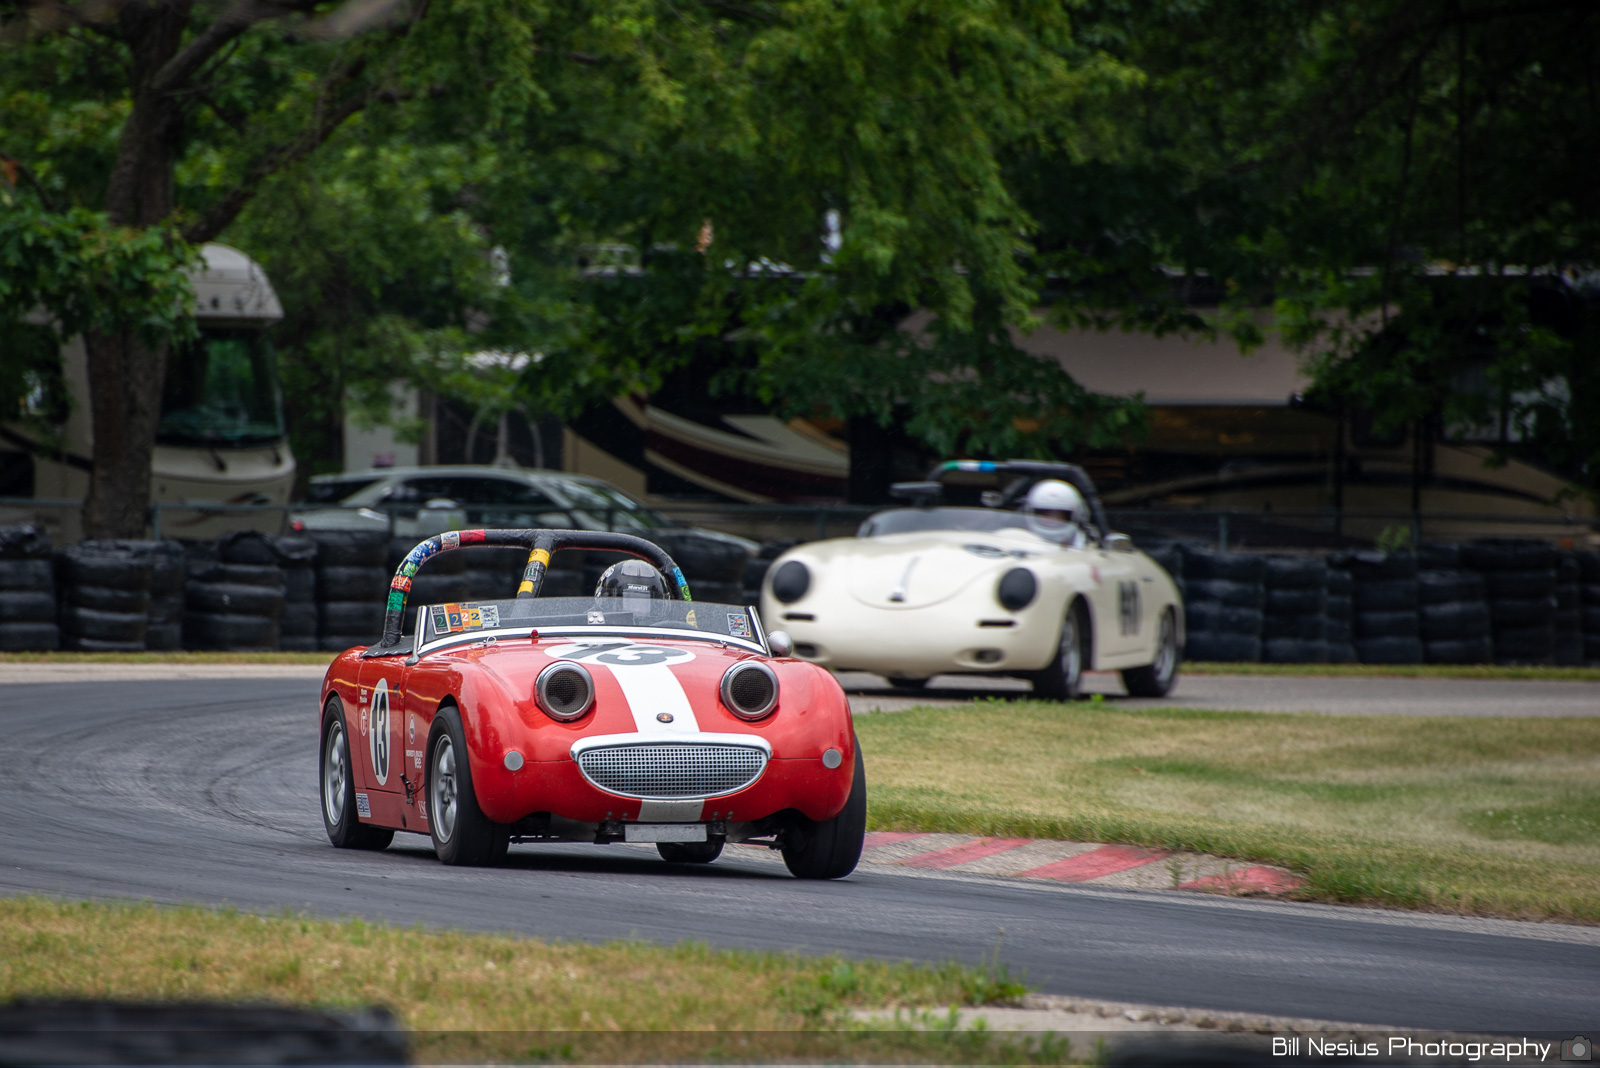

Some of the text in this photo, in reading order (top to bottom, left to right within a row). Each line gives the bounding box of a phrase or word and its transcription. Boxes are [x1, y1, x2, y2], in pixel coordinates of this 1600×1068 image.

[436, 616, 446, 627] 2
[451, 614, 460, 626] 2
[462, 612, 469, 622] 2
[471, 612, 480, 620] 2
[558, 642, 687, 666] 13
[371, 691, 388, 778] 13
